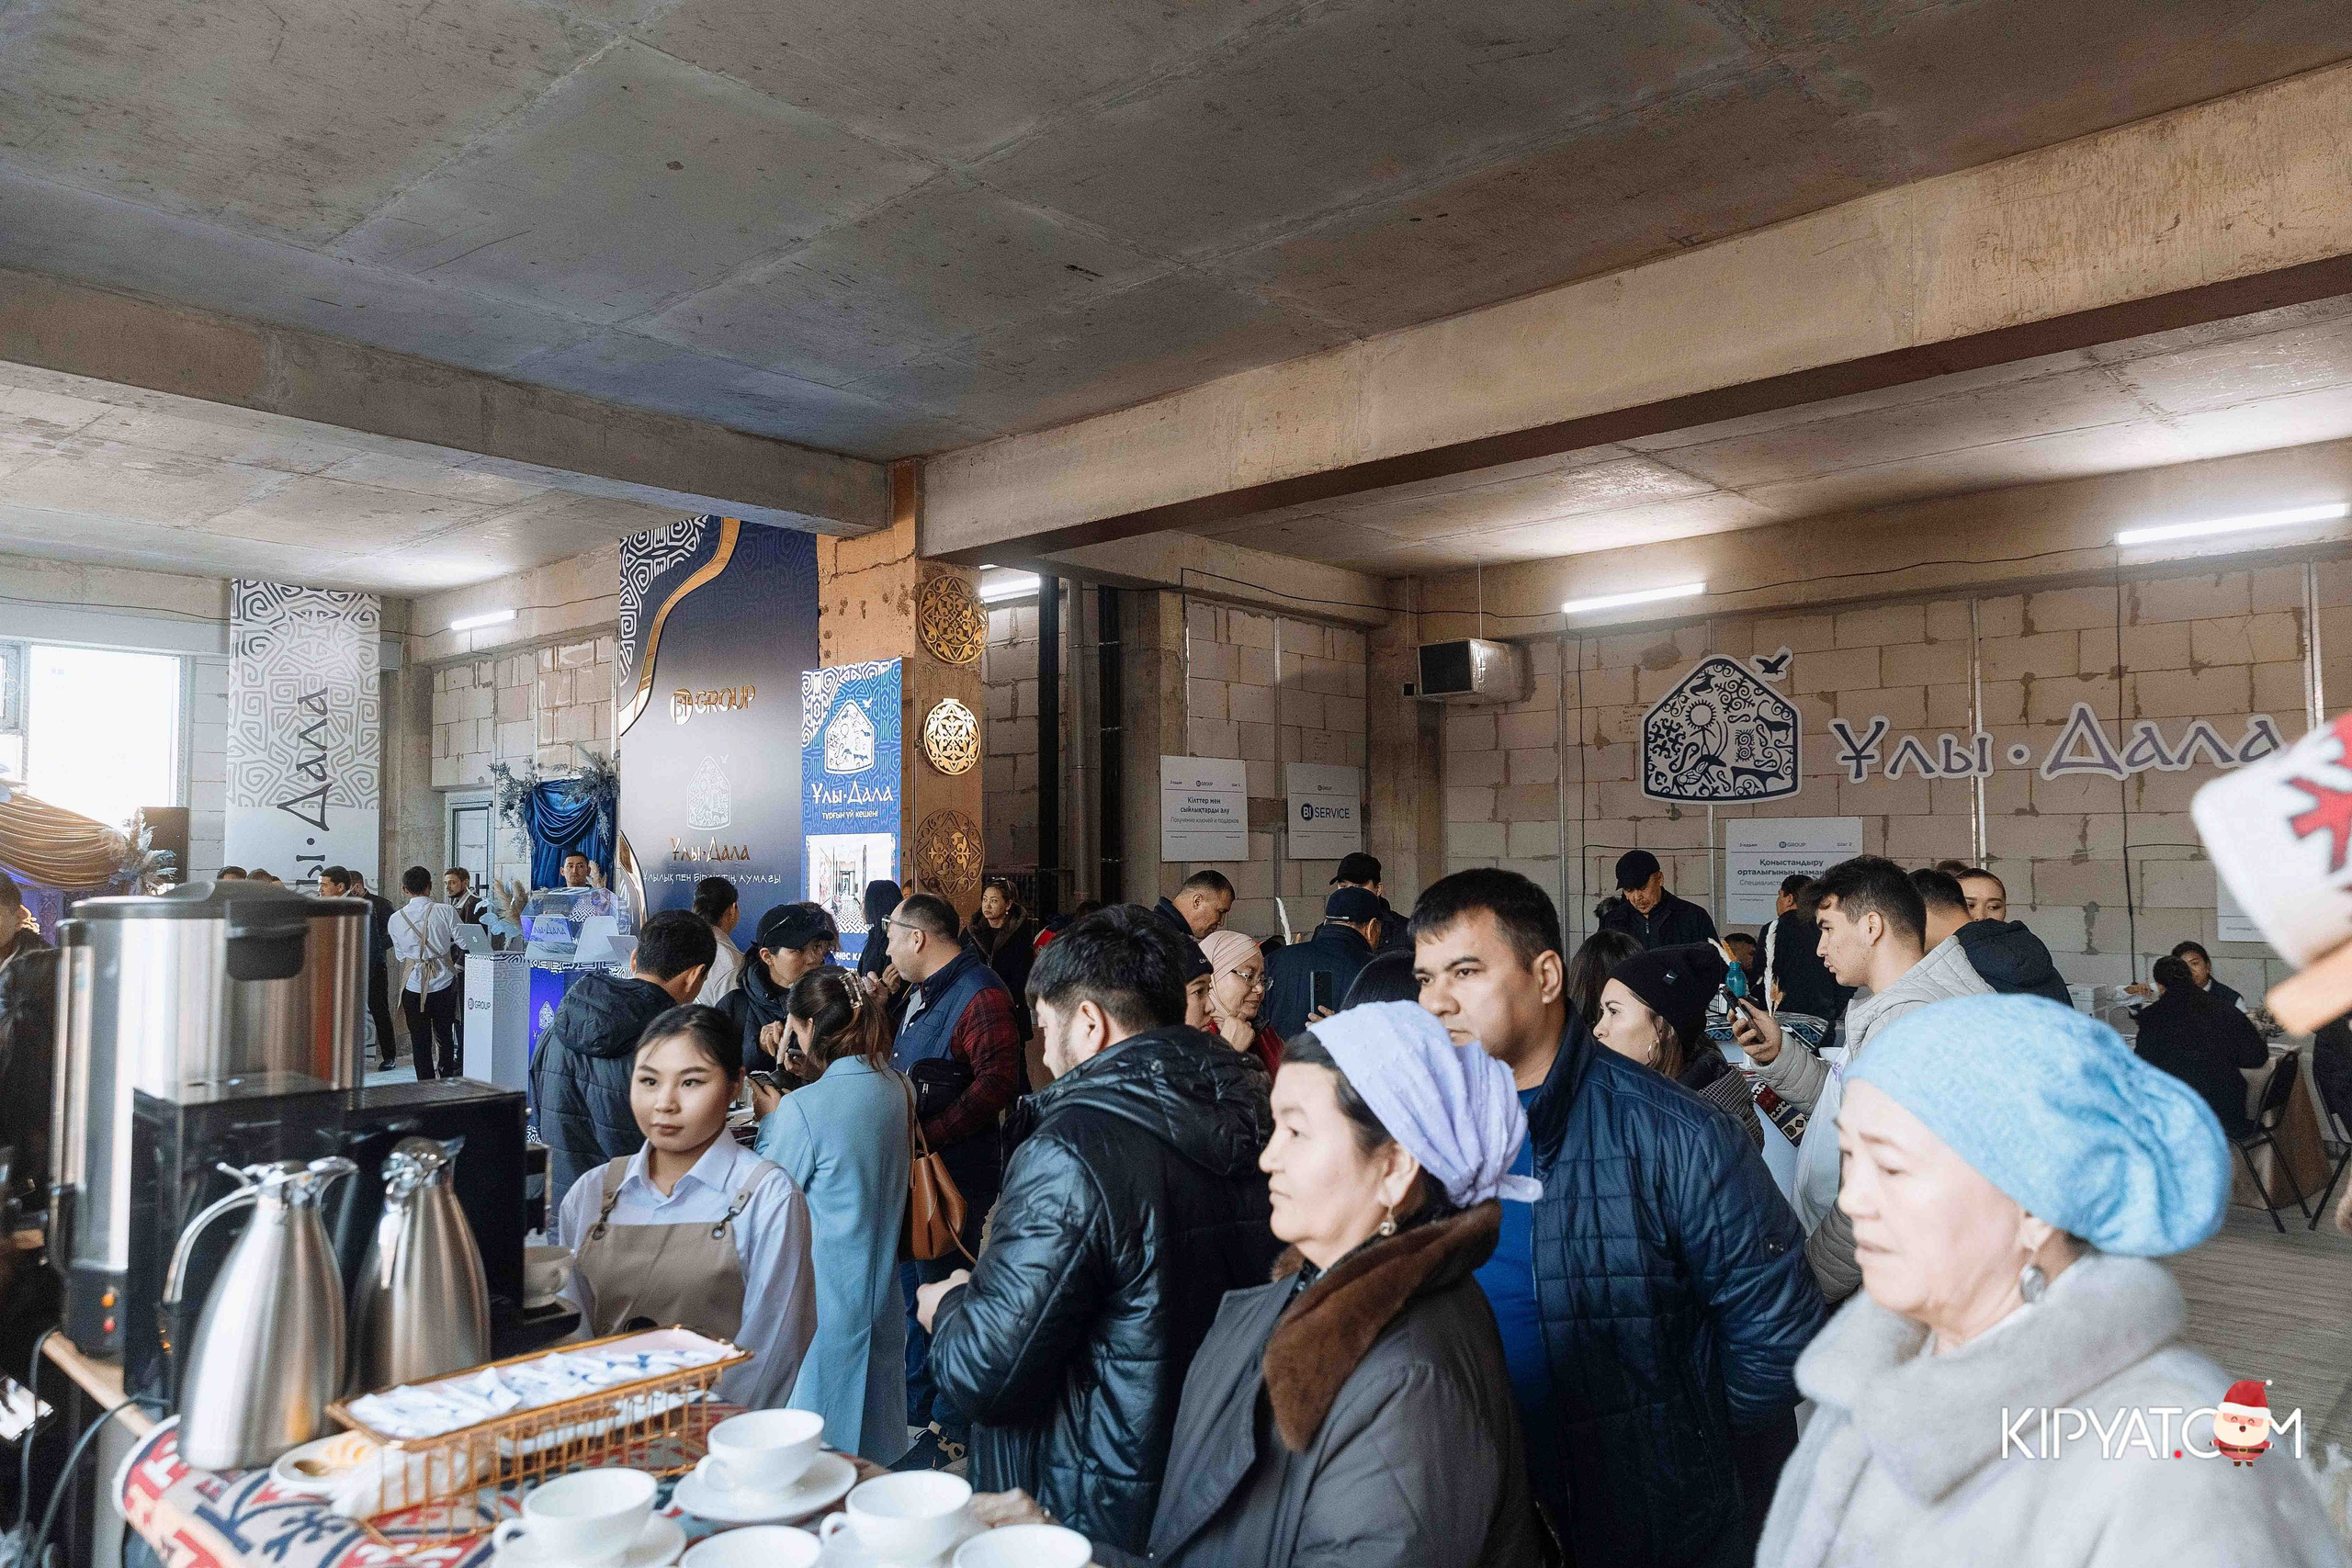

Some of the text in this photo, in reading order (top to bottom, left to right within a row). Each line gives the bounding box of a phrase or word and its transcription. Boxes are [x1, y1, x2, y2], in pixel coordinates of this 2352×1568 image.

[695, 685, 755, 714] GROUP
[1187, 796, 1209, 805] Кілттер
[1314, 807, 1351, 819] SERVICE
[1759, 859, 1824, 867] Қоныстандыру
